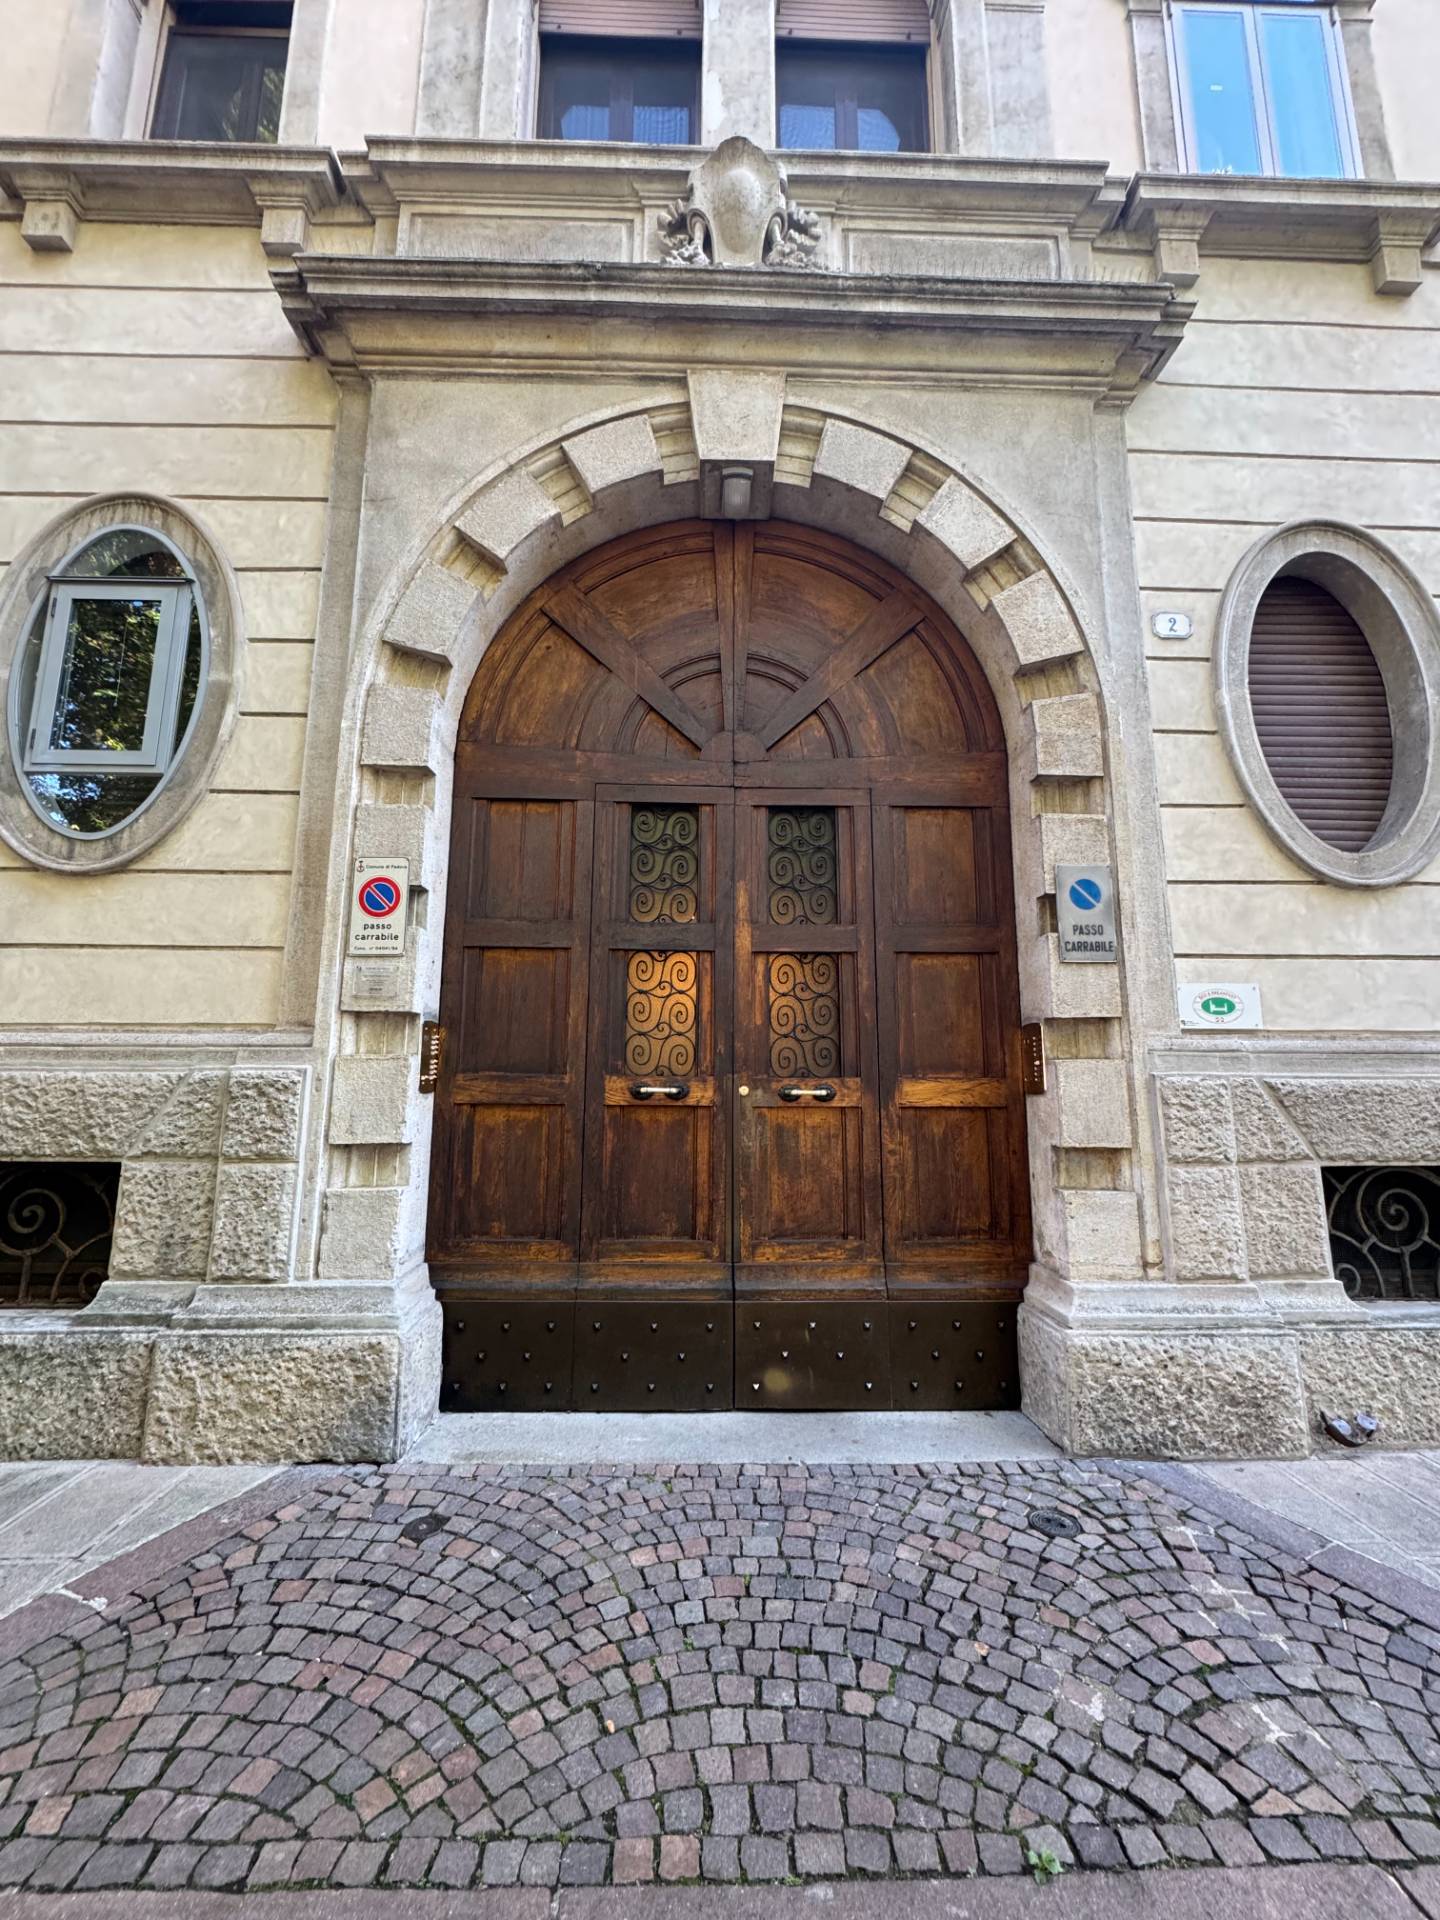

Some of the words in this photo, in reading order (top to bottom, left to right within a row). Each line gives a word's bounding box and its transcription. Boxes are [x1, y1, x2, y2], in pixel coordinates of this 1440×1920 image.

[1168, 617, 1177, 633] 2
[363, 923, 392, 931] passo
[1072, 924, 1104, 936] PASSO
[354, 932, 399, 941] carrabile
[1064, 940, 1114, 953] CARRABILE
